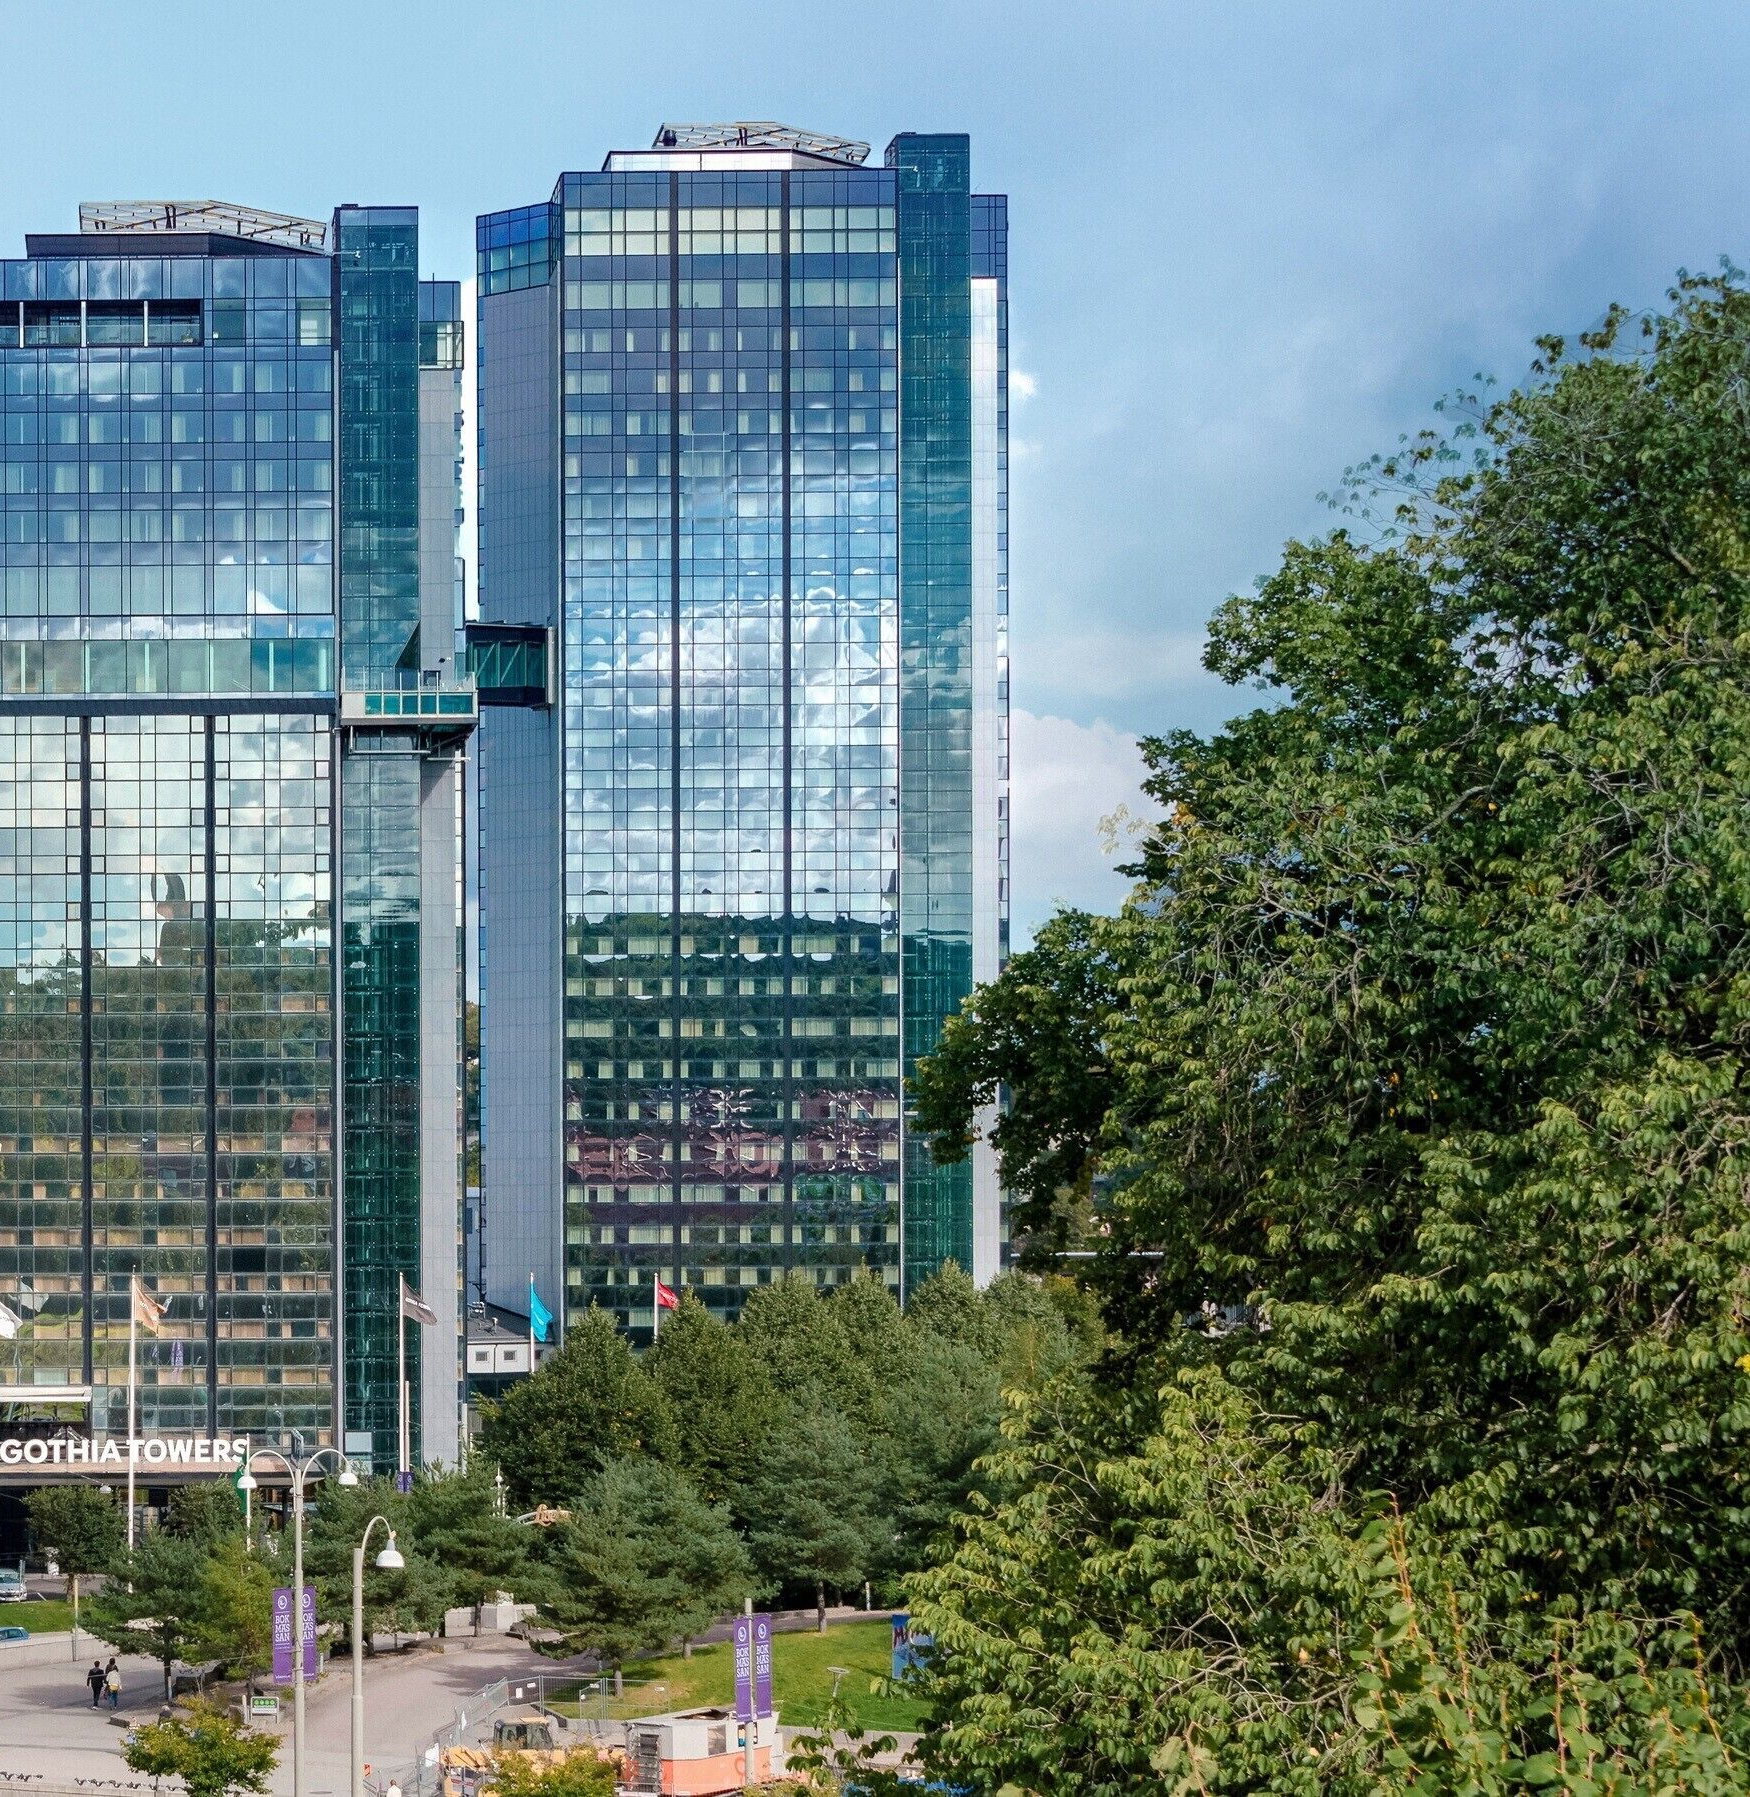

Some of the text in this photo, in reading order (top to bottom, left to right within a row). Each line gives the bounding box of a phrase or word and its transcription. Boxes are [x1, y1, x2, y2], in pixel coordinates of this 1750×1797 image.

[0, 1438, 247, 1465] GOTHIA TOWERS
[275, 1614, 290, 1624] BOK
[275, 1632, 290, 1643] SAN
[736, 1647, 749, 1658] BOK
[756, 1644, 769, 1655] BOK
[736, 1666, 750, 1678] SAN
[756, 1664, 769, 1675] SAN
